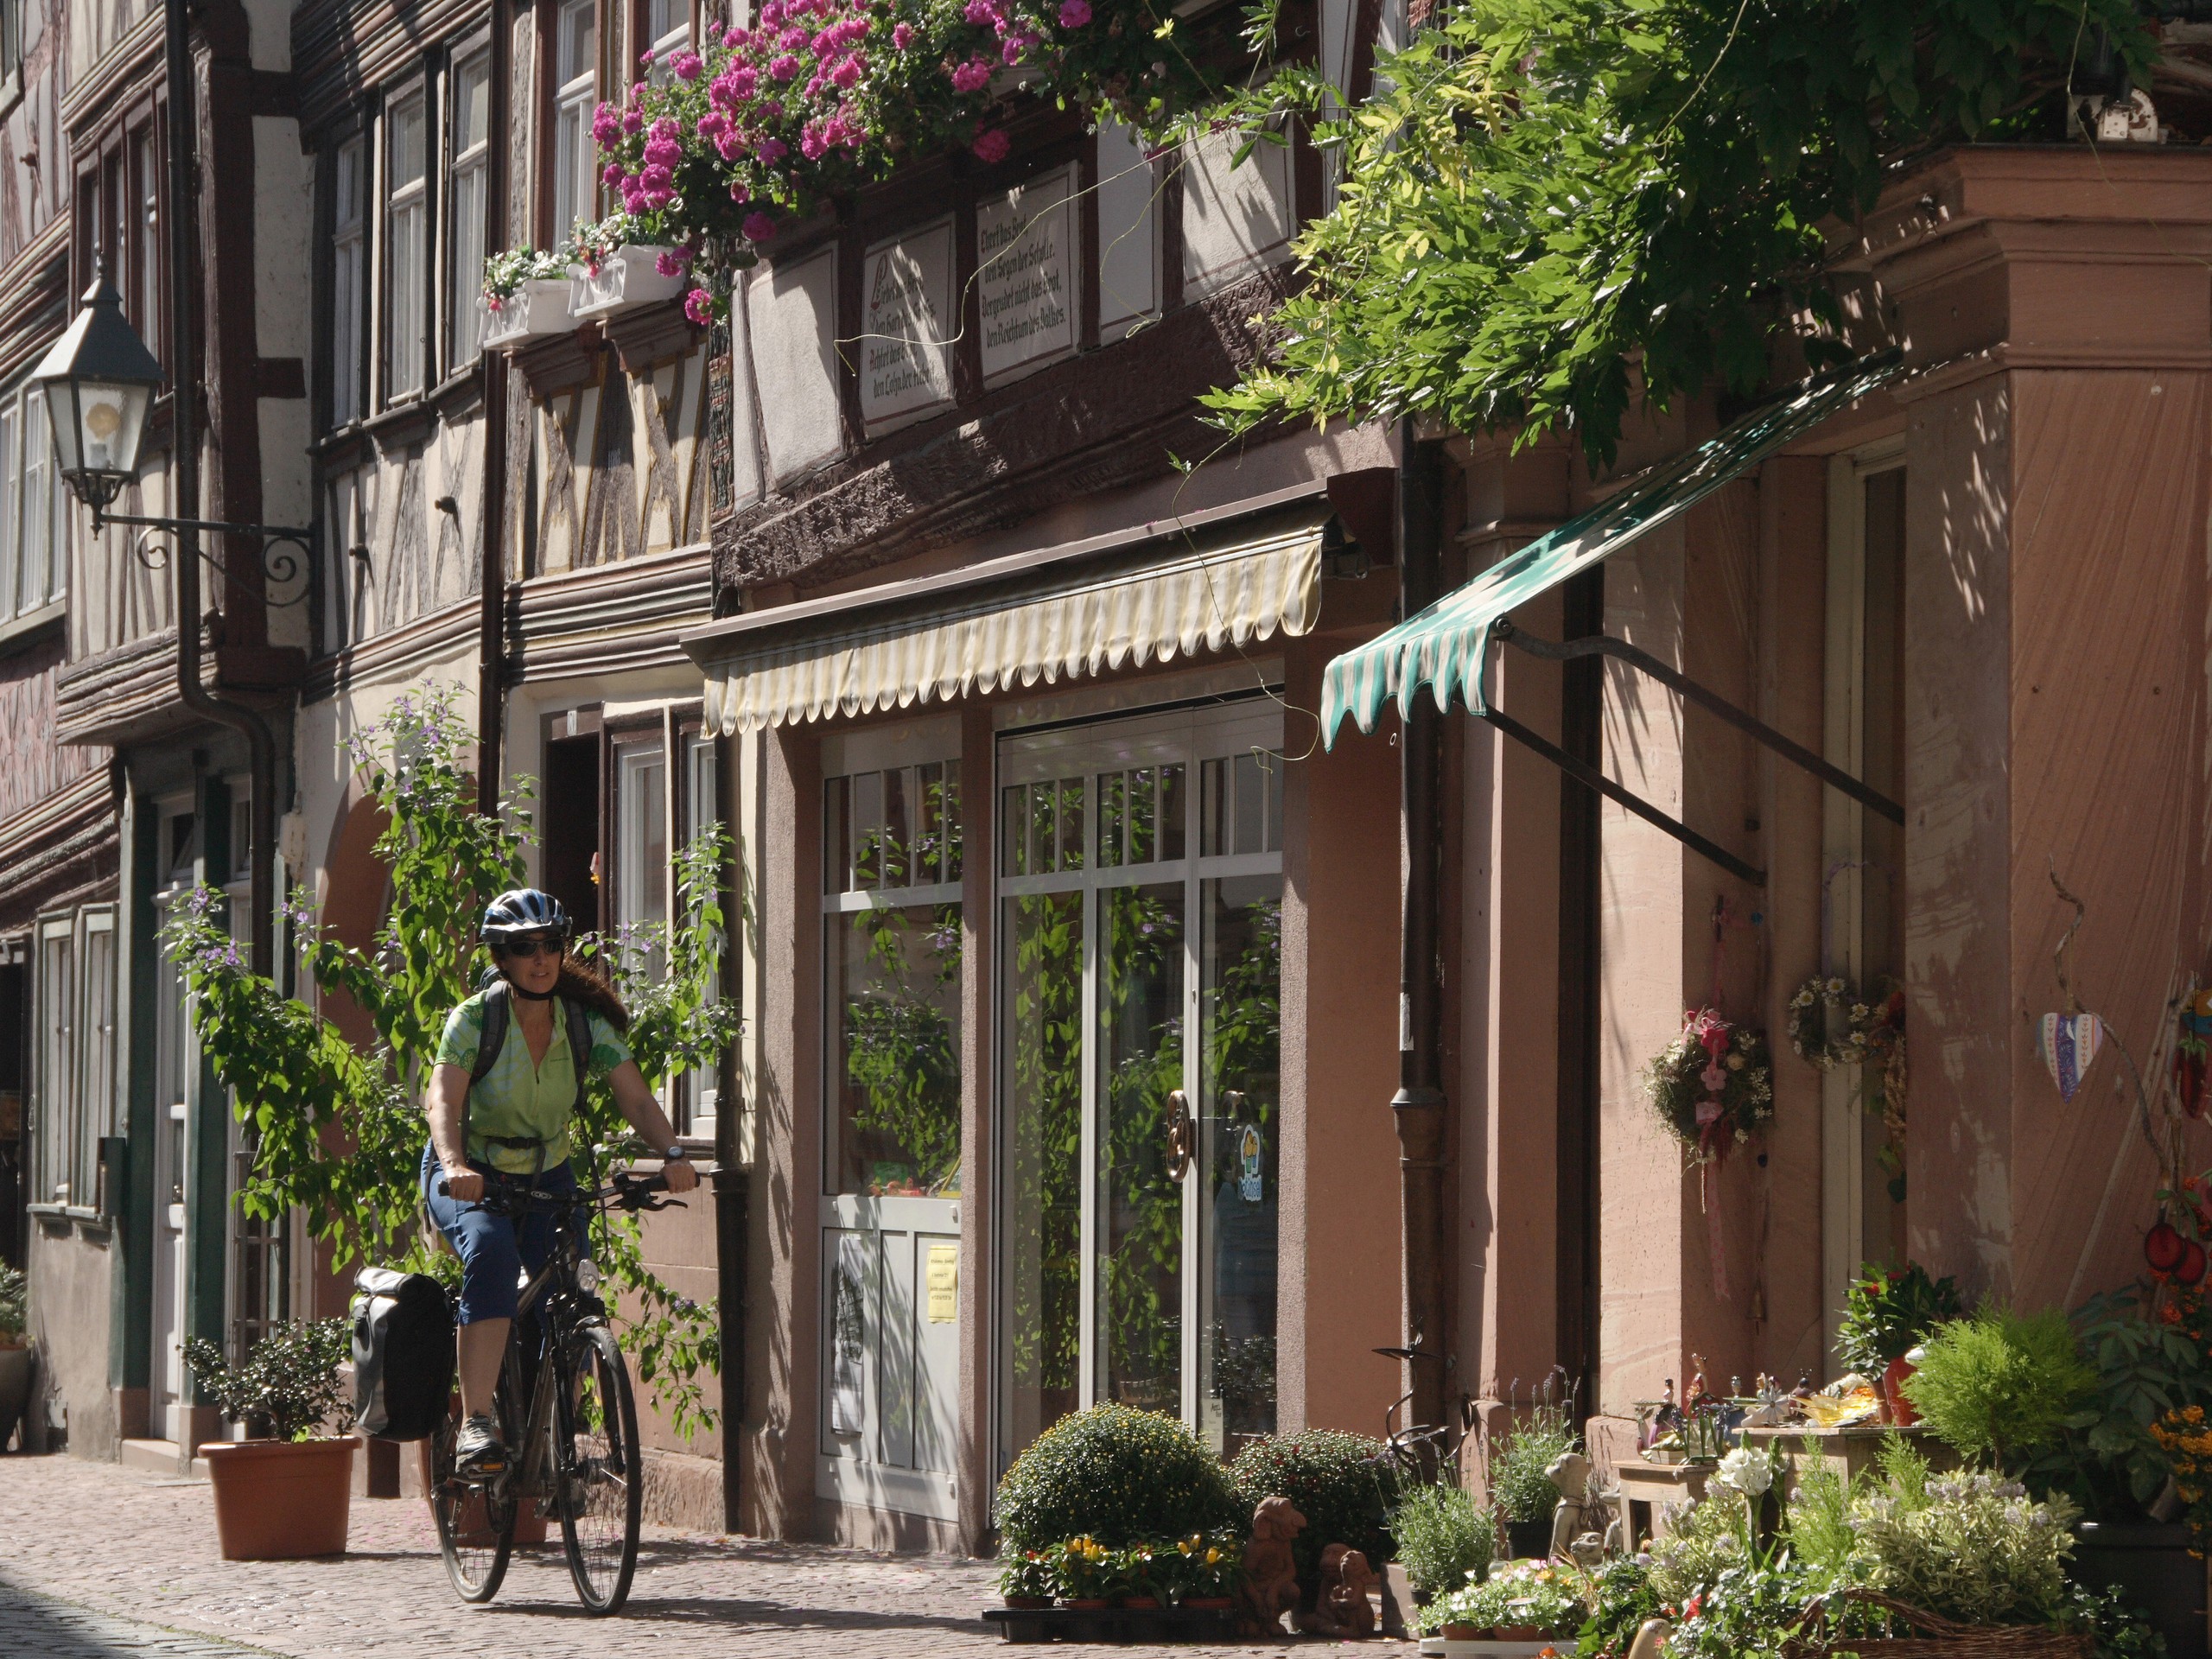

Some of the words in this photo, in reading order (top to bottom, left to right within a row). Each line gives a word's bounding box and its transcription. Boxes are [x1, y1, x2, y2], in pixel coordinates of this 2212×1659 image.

[980, 222, 999, 254] Ehret
[999, 222, 1011, 245] das
[984, 264, 996, 284] den
[997, 255, 1017, 283] Segen
[1017, 249, 1028, 272] der
[1014, 279, 1030, 308] nicht
[1031, 278, 1042, 299] das
[1042, 266, 1062, 296] Brot,
[986, 327, 998, 349] den
[997, 314, 1028, 348] Reichtum
[1028, 312, 1039, 334] des
[869, 344, 889, 374] Achtet
[889, 343, 900, 365] das
[873, 377, 884, 399] den
[884, 370, 901, 398] Lohn
[901, 368, 912, 391] der
